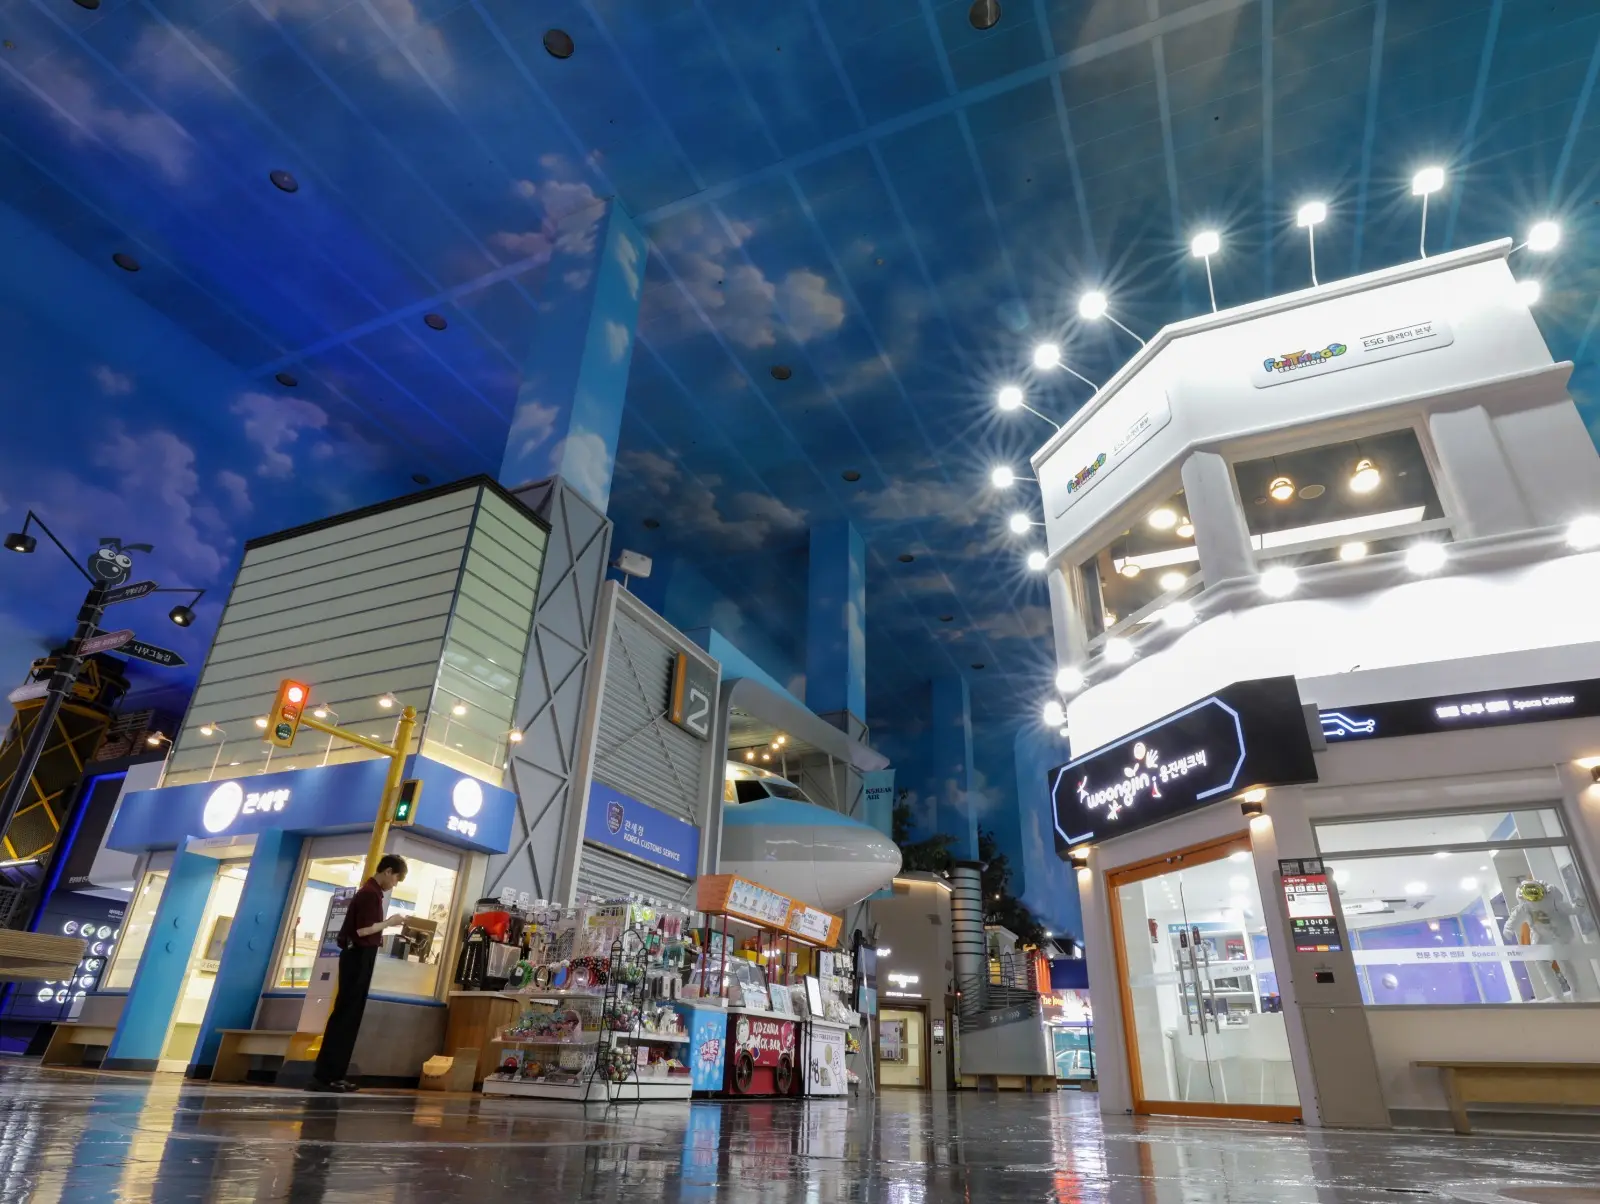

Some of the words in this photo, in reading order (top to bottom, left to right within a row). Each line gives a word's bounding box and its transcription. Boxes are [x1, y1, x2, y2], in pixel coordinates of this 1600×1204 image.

[1363, 337, 1384, 348] ESG
[1386, 330, 1413, 343] 플레이
[1414, 325, 1432, 336] 본부
[1296, 357, 1327, 369] HEROES
[1513, 700, 1542, 710] Space
[1542, 696, 1575, 706] Center
[686, 687, 709, 736] 2
[865, 786, 892, 795] KOREAN
[624, 820, 644, 837] 관세청
[623, 833, 640, 846] KOREA
[640, 840, 662, 855] CUSTOMS
[662, 848, 681, 862] SERVICE
[1471, 950, 1496, 959] Space
[990, 1015, 998, 1023] 3F
